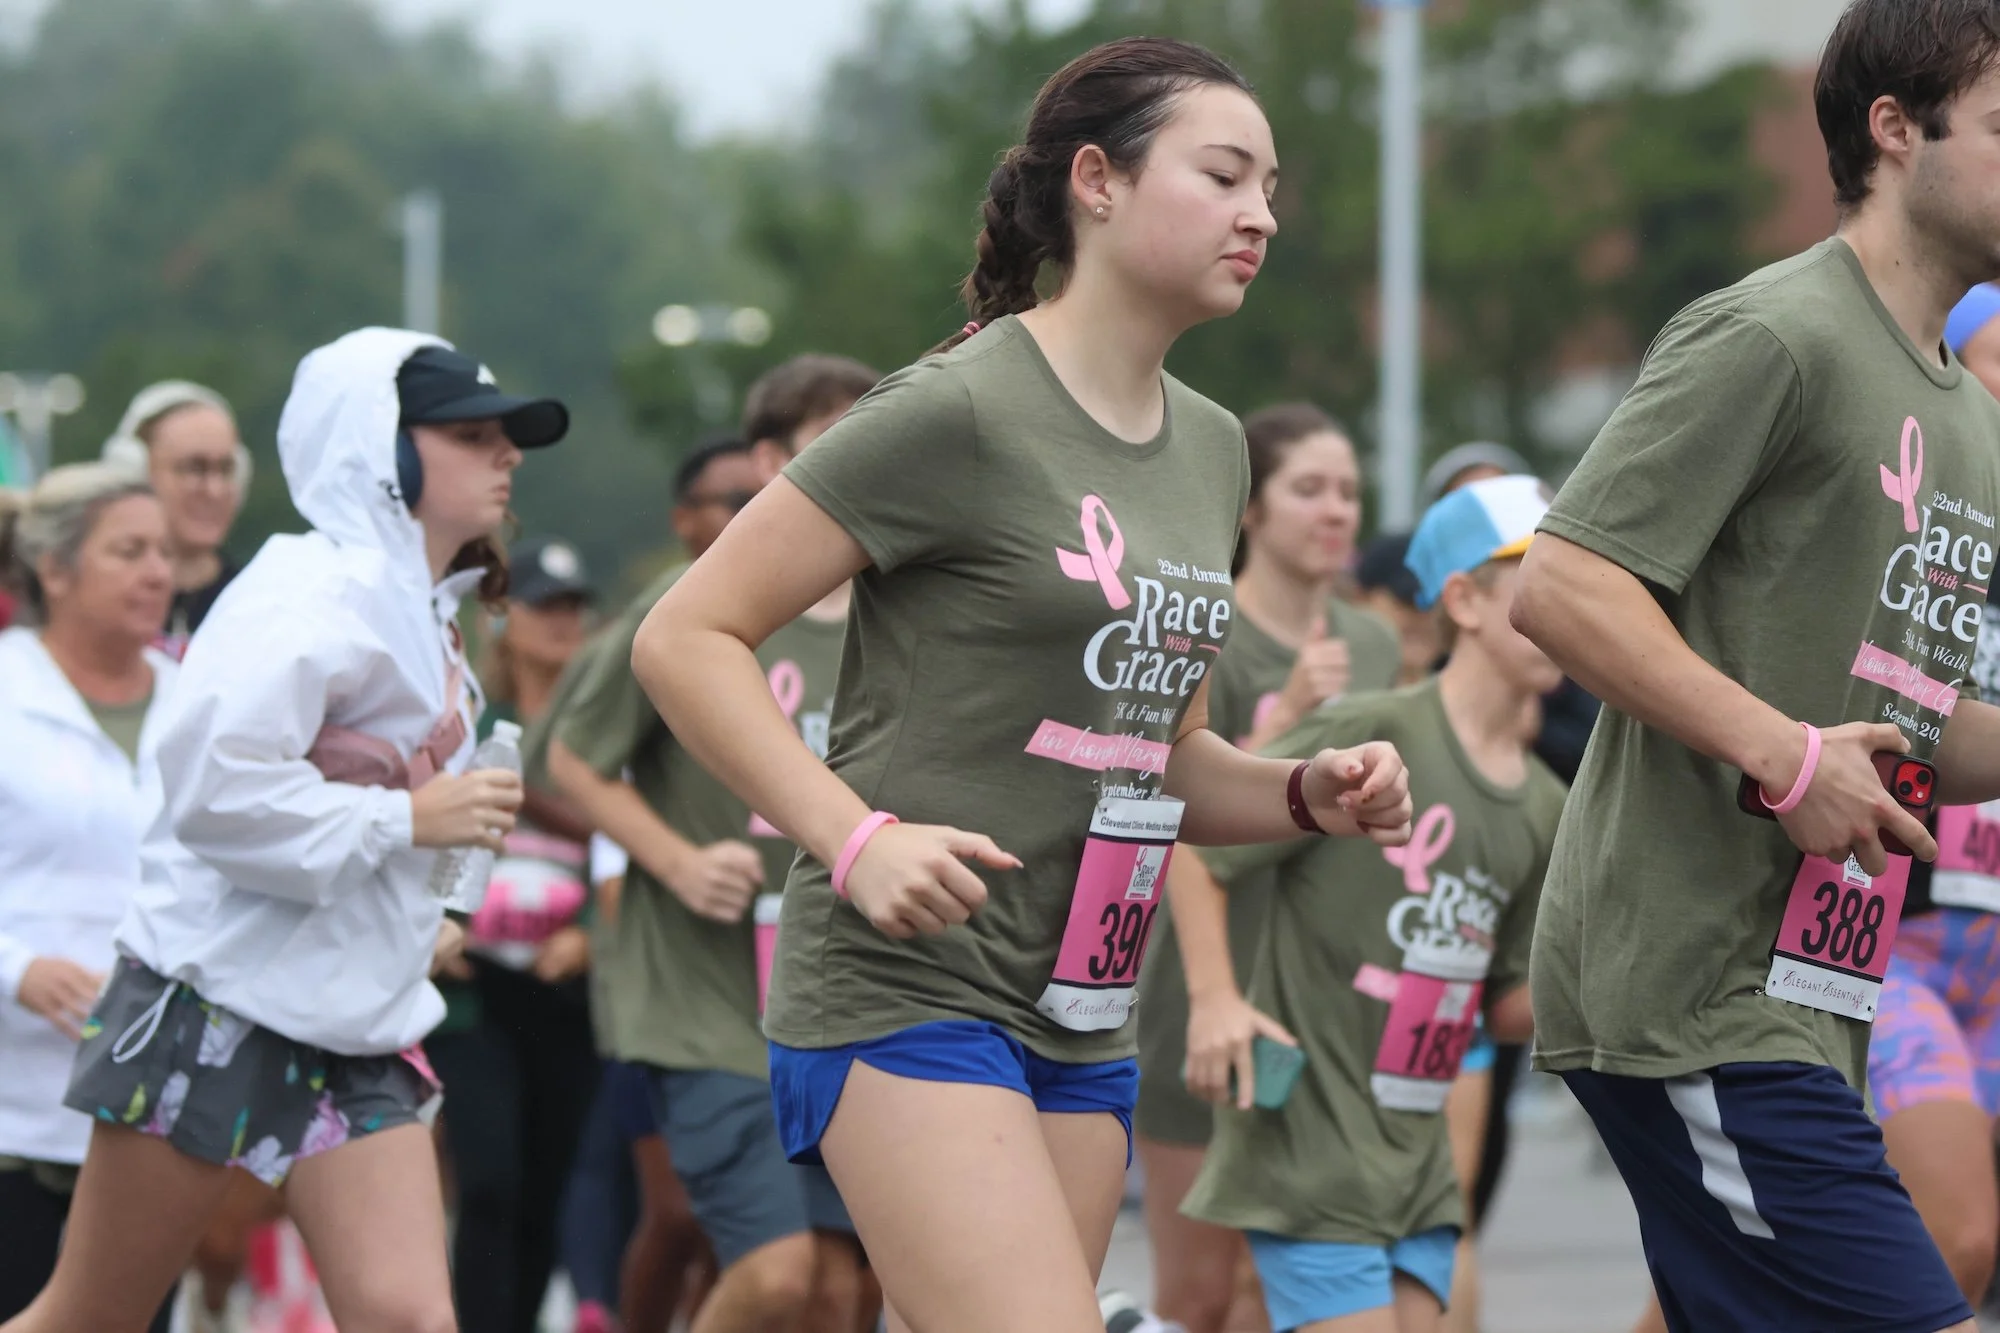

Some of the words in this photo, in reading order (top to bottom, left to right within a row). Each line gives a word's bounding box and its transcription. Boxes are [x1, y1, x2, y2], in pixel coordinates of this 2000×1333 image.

[1932, 490, 1962, 516] 22nd
[1158, 558, 1188, 580] 22nd
[1927, 567, 1959, 590] With
[1880, 543, 1983, 642] Gace
[1124, 575, 1230, 648] Race
[1164, 634, 1192, 653] With
[1083, 619, 1206, 697] Grace
[1932, 644, 1968, 672] Walk
[1126, 703, 1137, 721] &
[1136, 704, 1160, 724] Fun
[1100, 816, 1131, 829] Cleveland
[1801, 881, 1885, 969] 388
